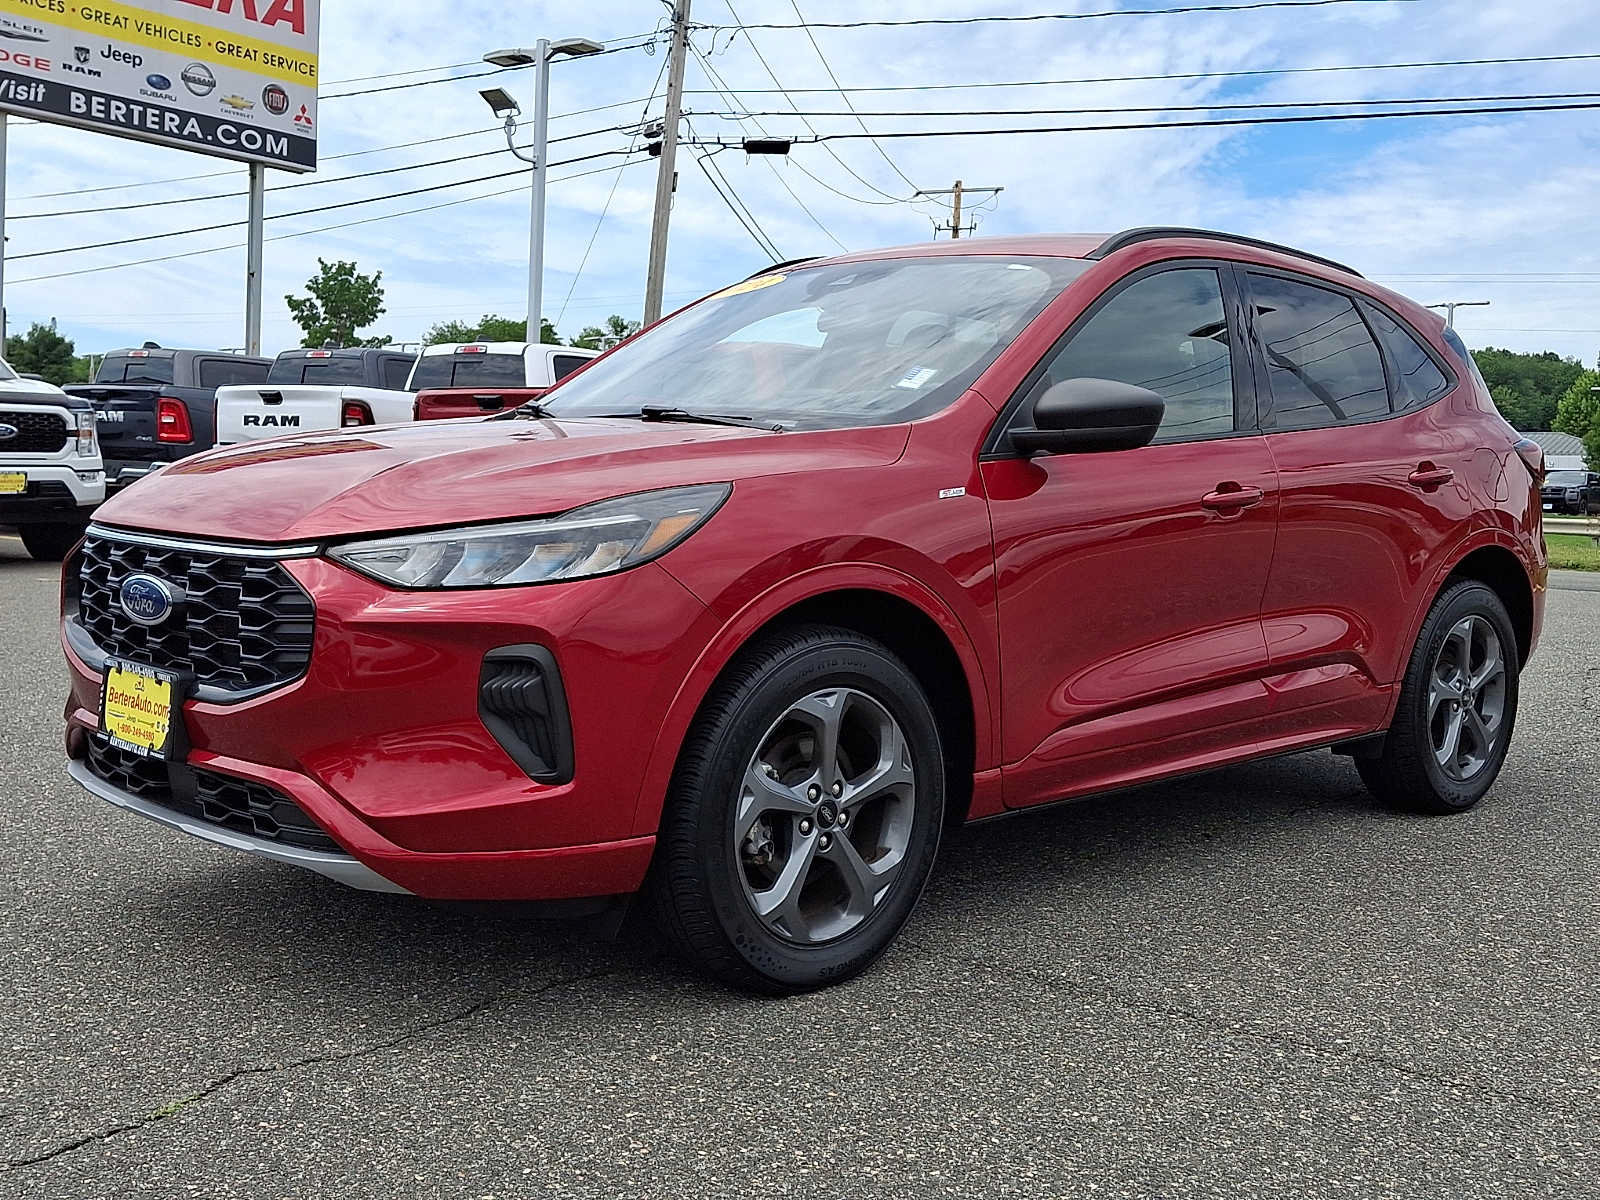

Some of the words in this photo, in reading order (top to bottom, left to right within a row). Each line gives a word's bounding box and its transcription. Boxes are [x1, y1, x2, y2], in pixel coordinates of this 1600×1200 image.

[10, 0, 65, 13] ICES
[80, 6, 129, 30] GREAT
[134, 18, 202, 48] VEHICLES
[215, 40, 259, 62] GREAT
[262, 51, 316, 77] SERVICE
[100, 44, 143, 68] Jeep
[62, 62, 102, 78] RAM
[183, 73, 214, 89] NISSAN
[139, 88, 178, 103] SUBARU
[268, 91, 286, 110] FIAT
[69, 90, 289, 157] BERTERA.COM
[95, 410, 124, 422] AM
[243, 415, 300, 427] RAM
[127, 584, 156, 613] Ford
[108, 686, 169, 719] BerteraAuto.com
